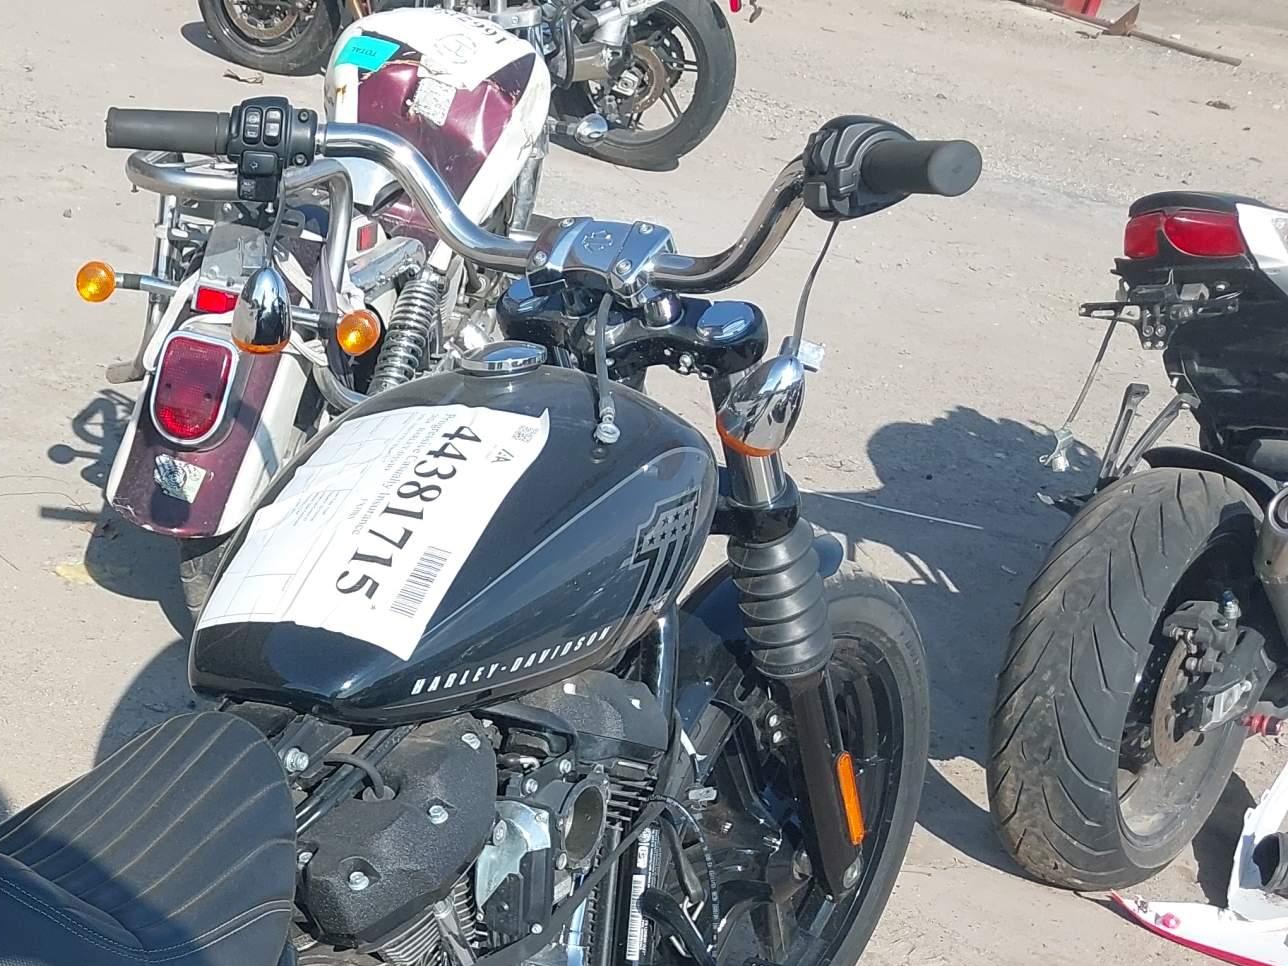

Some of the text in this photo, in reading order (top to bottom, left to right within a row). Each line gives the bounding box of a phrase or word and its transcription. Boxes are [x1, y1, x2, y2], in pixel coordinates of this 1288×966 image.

[352, 46, 377, 57] TOTAL
[335, 425, 482, 600] 44381715
[351, 492, 391, 535] Insurance
[411, 626, 613, 695] HARLEY-DAVIDSON
